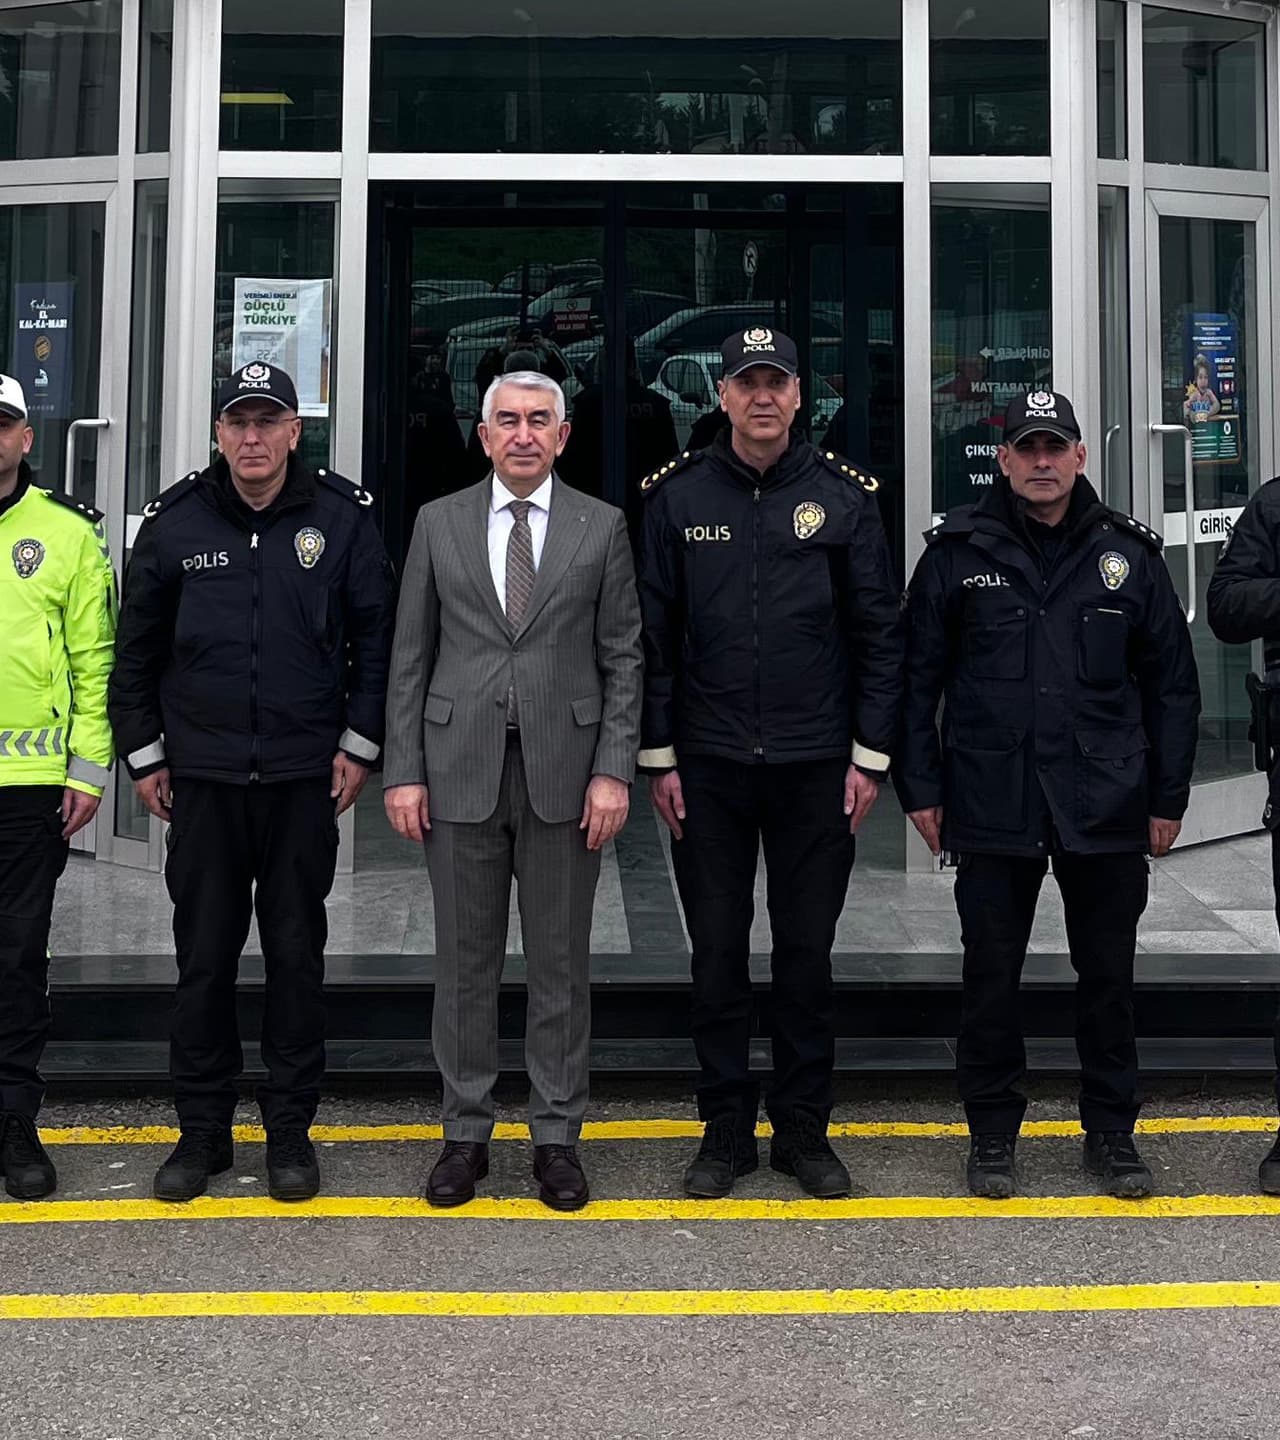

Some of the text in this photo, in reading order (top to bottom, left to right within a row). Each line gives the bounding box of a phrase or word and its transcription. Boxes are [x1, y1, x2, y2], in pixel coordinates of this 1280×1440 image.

[244, 299, 286, 314] GÜÇLÜ
[244, 313, 297, 325] TÜRKİYE
[965, 444, 998, 459] ÇIKIŞ
[969, 473, 994, 485] YAN
[684, 524, 732, 543] POLİS
[182, 551, 230, 572] POLİS
